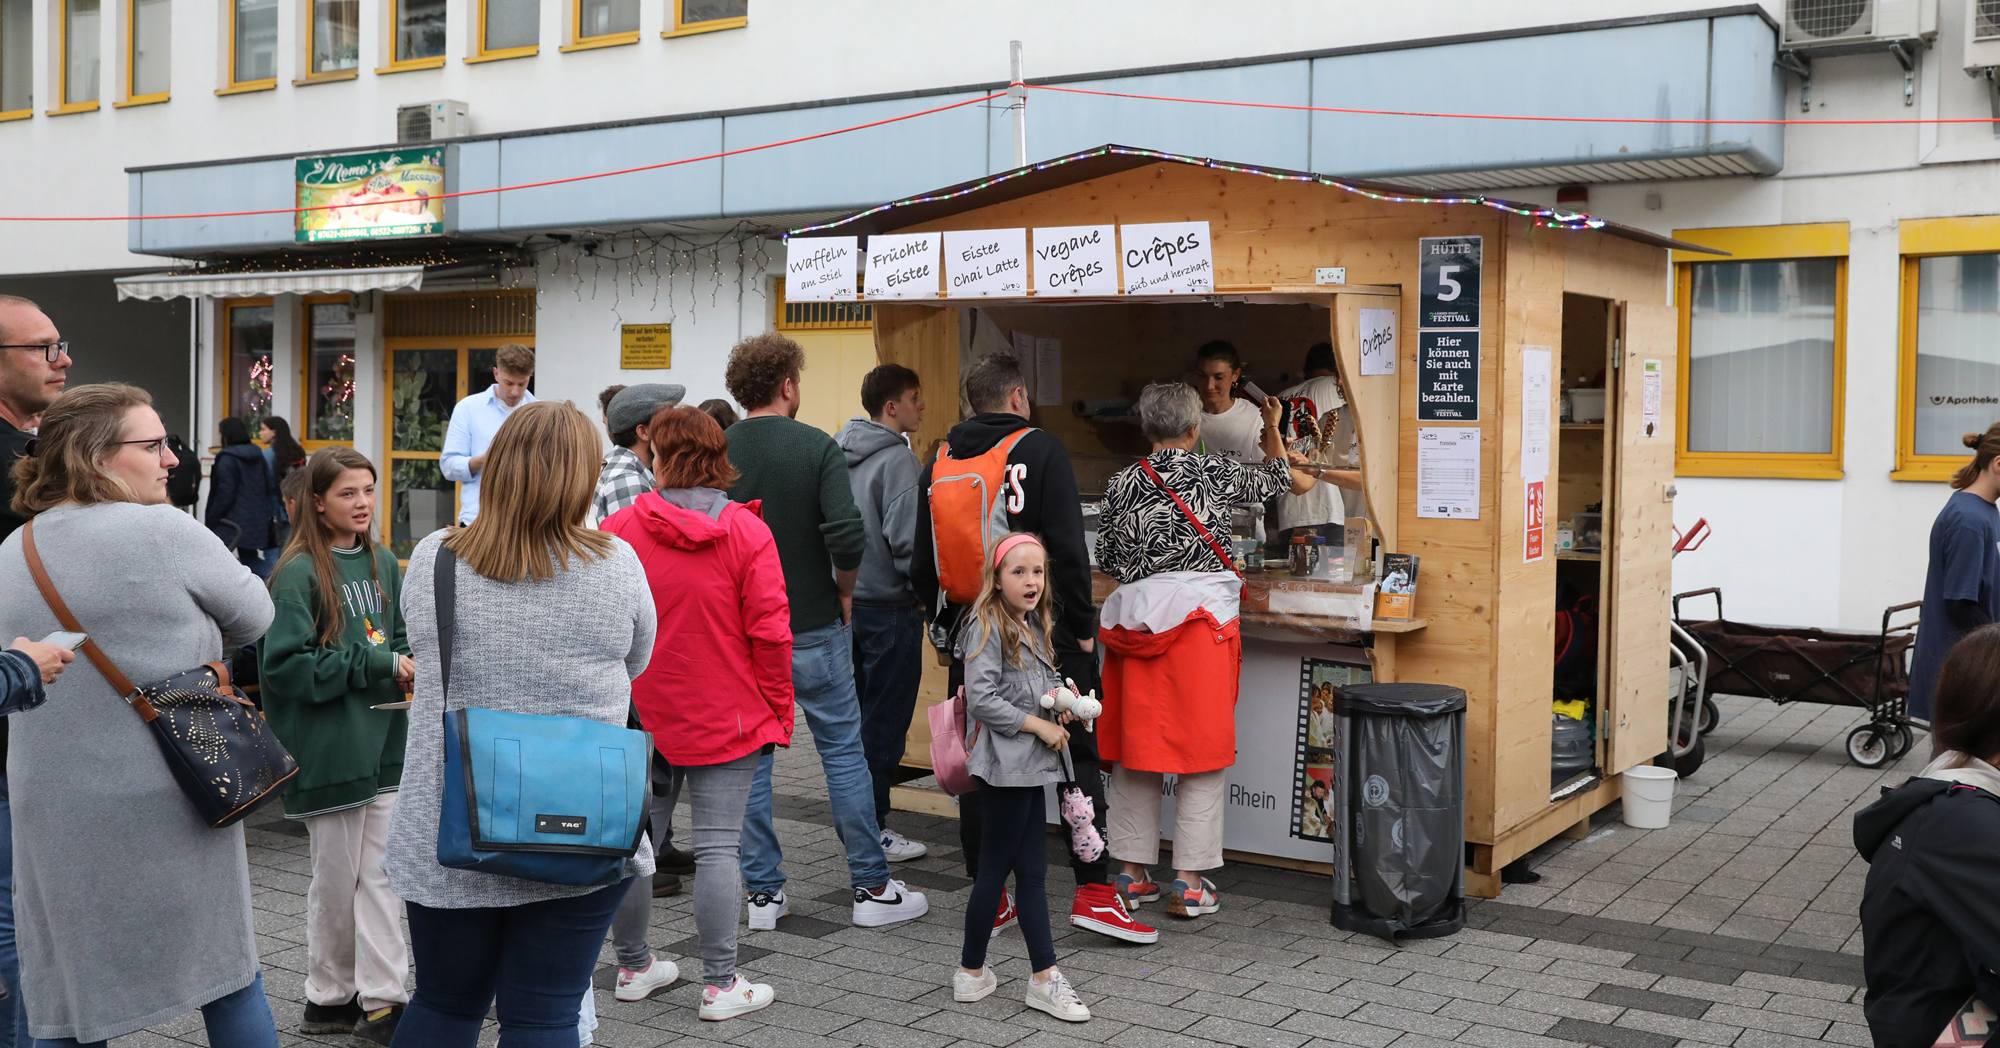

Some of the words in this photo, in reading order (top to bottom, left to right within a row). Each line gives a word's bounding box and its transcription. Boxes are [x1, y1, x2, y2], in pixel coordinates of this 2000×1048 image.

[304, 159, 377, 186] Momo's
[400, 169, 442, 185] Massage
[872, 239, 929, 269] Früchte
[961, 242, 1000, 262] Eistee
[1126, 232, 1200, 269] Crêpes
[1430, 241, 1472, 255] HÜTTE
[789, 246, 848, 273] Waffeln
[986, 257, 1020, 276] Latte
[800, 279, 817, 290] am
[819, 267, 842, 284] Stiel
[886, 264, 930, 288] Eistee
[1049, 260, 1103, 288] Crêpes
[1150, 271, 1170, 286] und
[1171, 258, 1210, 280] herzhaft
[1437, 265, 1461, 301] 5
[1433, 314, 1471, 322] FESTIVAL
[1362, 326, 1393, 357] Crêpes
[1437, 336, 1461, 347] Hier
[1428, 347, 1470, 358] können
[1426, 359, 1442, 369] Sie
[1444, 359, 1471, 369] auch
[1438, 370, 1458, 380] mit
[1433, 382, 1464, 391] Karte
[1422, 392, 1474, 403] bezahlen.
[1946, 396, 1999, 405] Apotheke
[1229, 784, 1277, 811] Rhein
